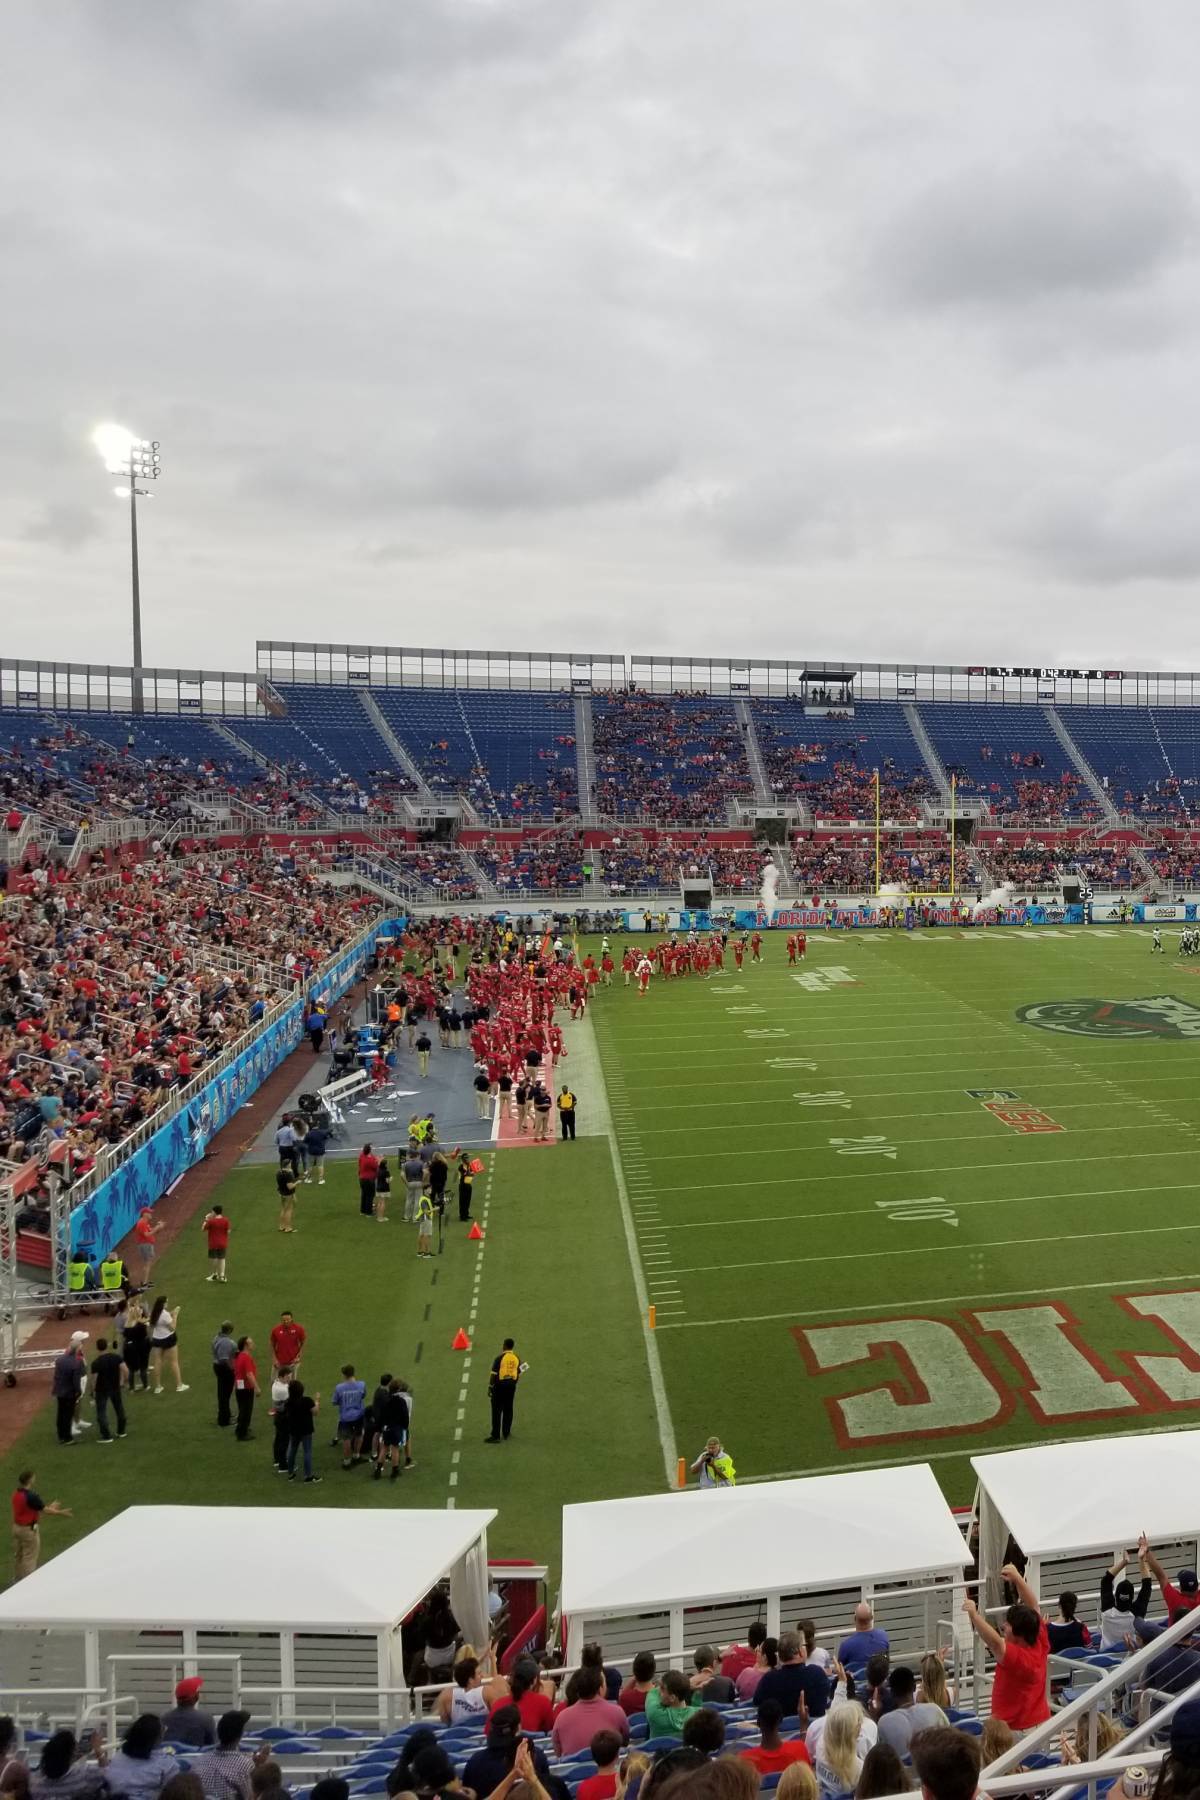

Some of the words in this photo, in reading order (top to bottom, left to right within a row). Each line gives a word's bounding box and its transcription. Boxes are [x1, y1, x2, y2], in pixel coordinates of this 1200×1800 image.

[1080, 888, 1093, 899] 25
[793, 1090, 850, 1106] 30
[829, 1135, 897, 1155] 20
[875, 1196, 956, 1221] 10
